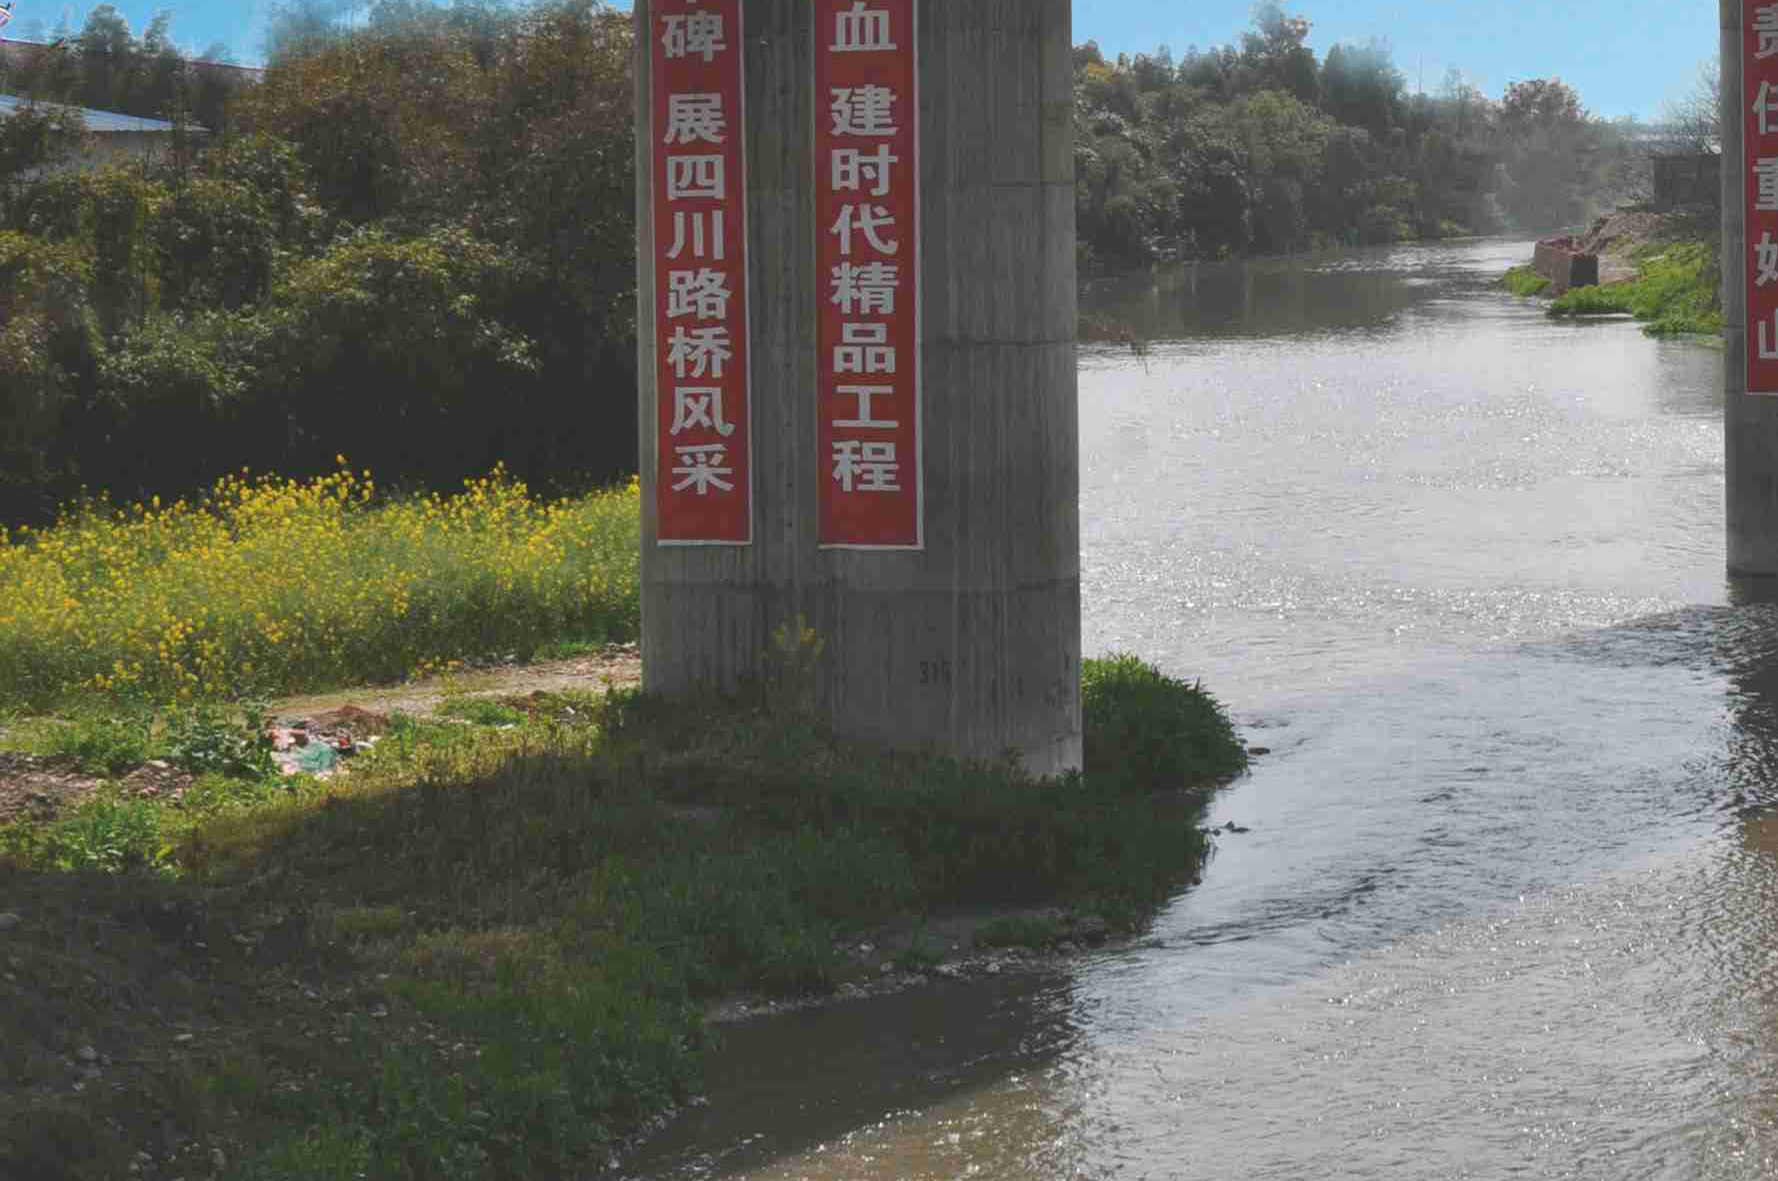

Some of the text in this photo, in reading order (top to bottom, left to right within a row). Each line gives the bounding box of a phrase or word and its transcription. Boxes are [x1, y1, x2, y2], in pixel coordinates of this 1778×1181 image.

[663, 92, 736, 496] 展四川路桥风采
[829, 83, 902, 493] 建时代精品工程
